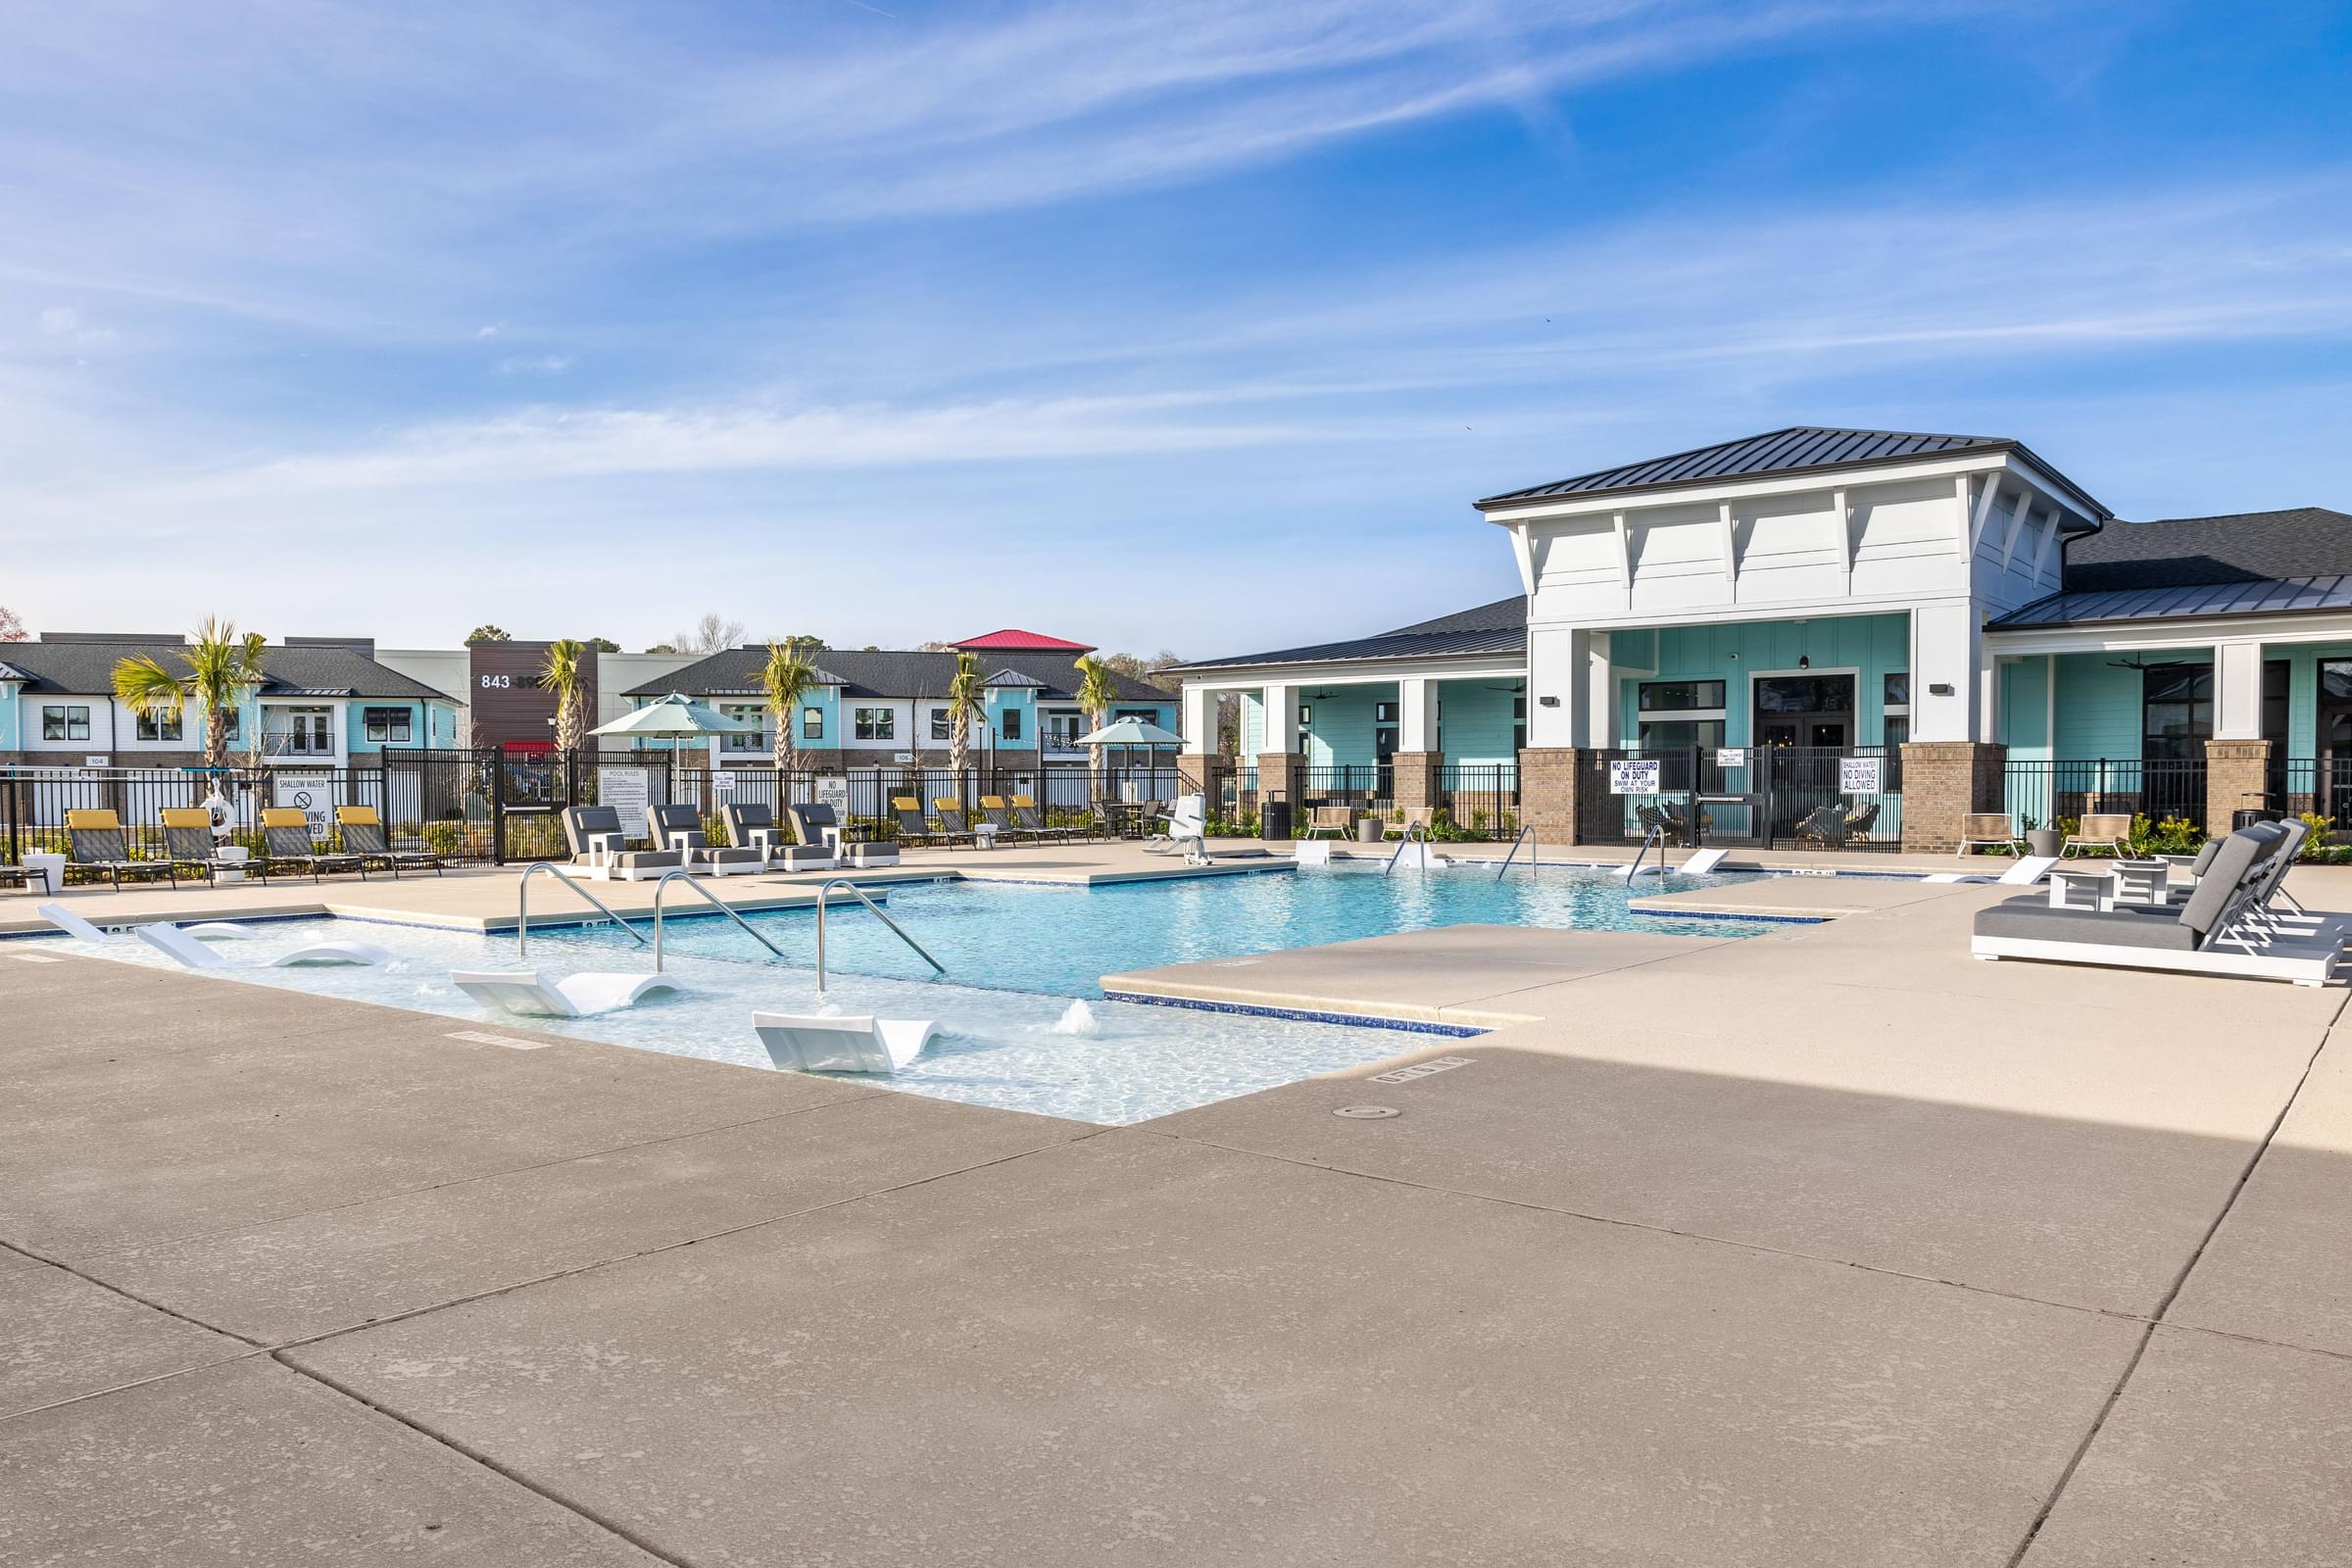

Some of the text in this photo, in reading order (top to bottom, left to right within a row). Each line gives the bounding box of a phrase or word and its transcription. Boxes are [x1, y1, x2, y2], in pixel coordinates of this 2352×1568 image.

[1612, 761, 1657, 770] NO LIFEGUARD
[1843, 769, 1876, 779] NO DIVING
[829, 780, 836, 789] NO
[1844, 780, 1875, 790] ALLOWED
[305, 811, 325, 822] VING
